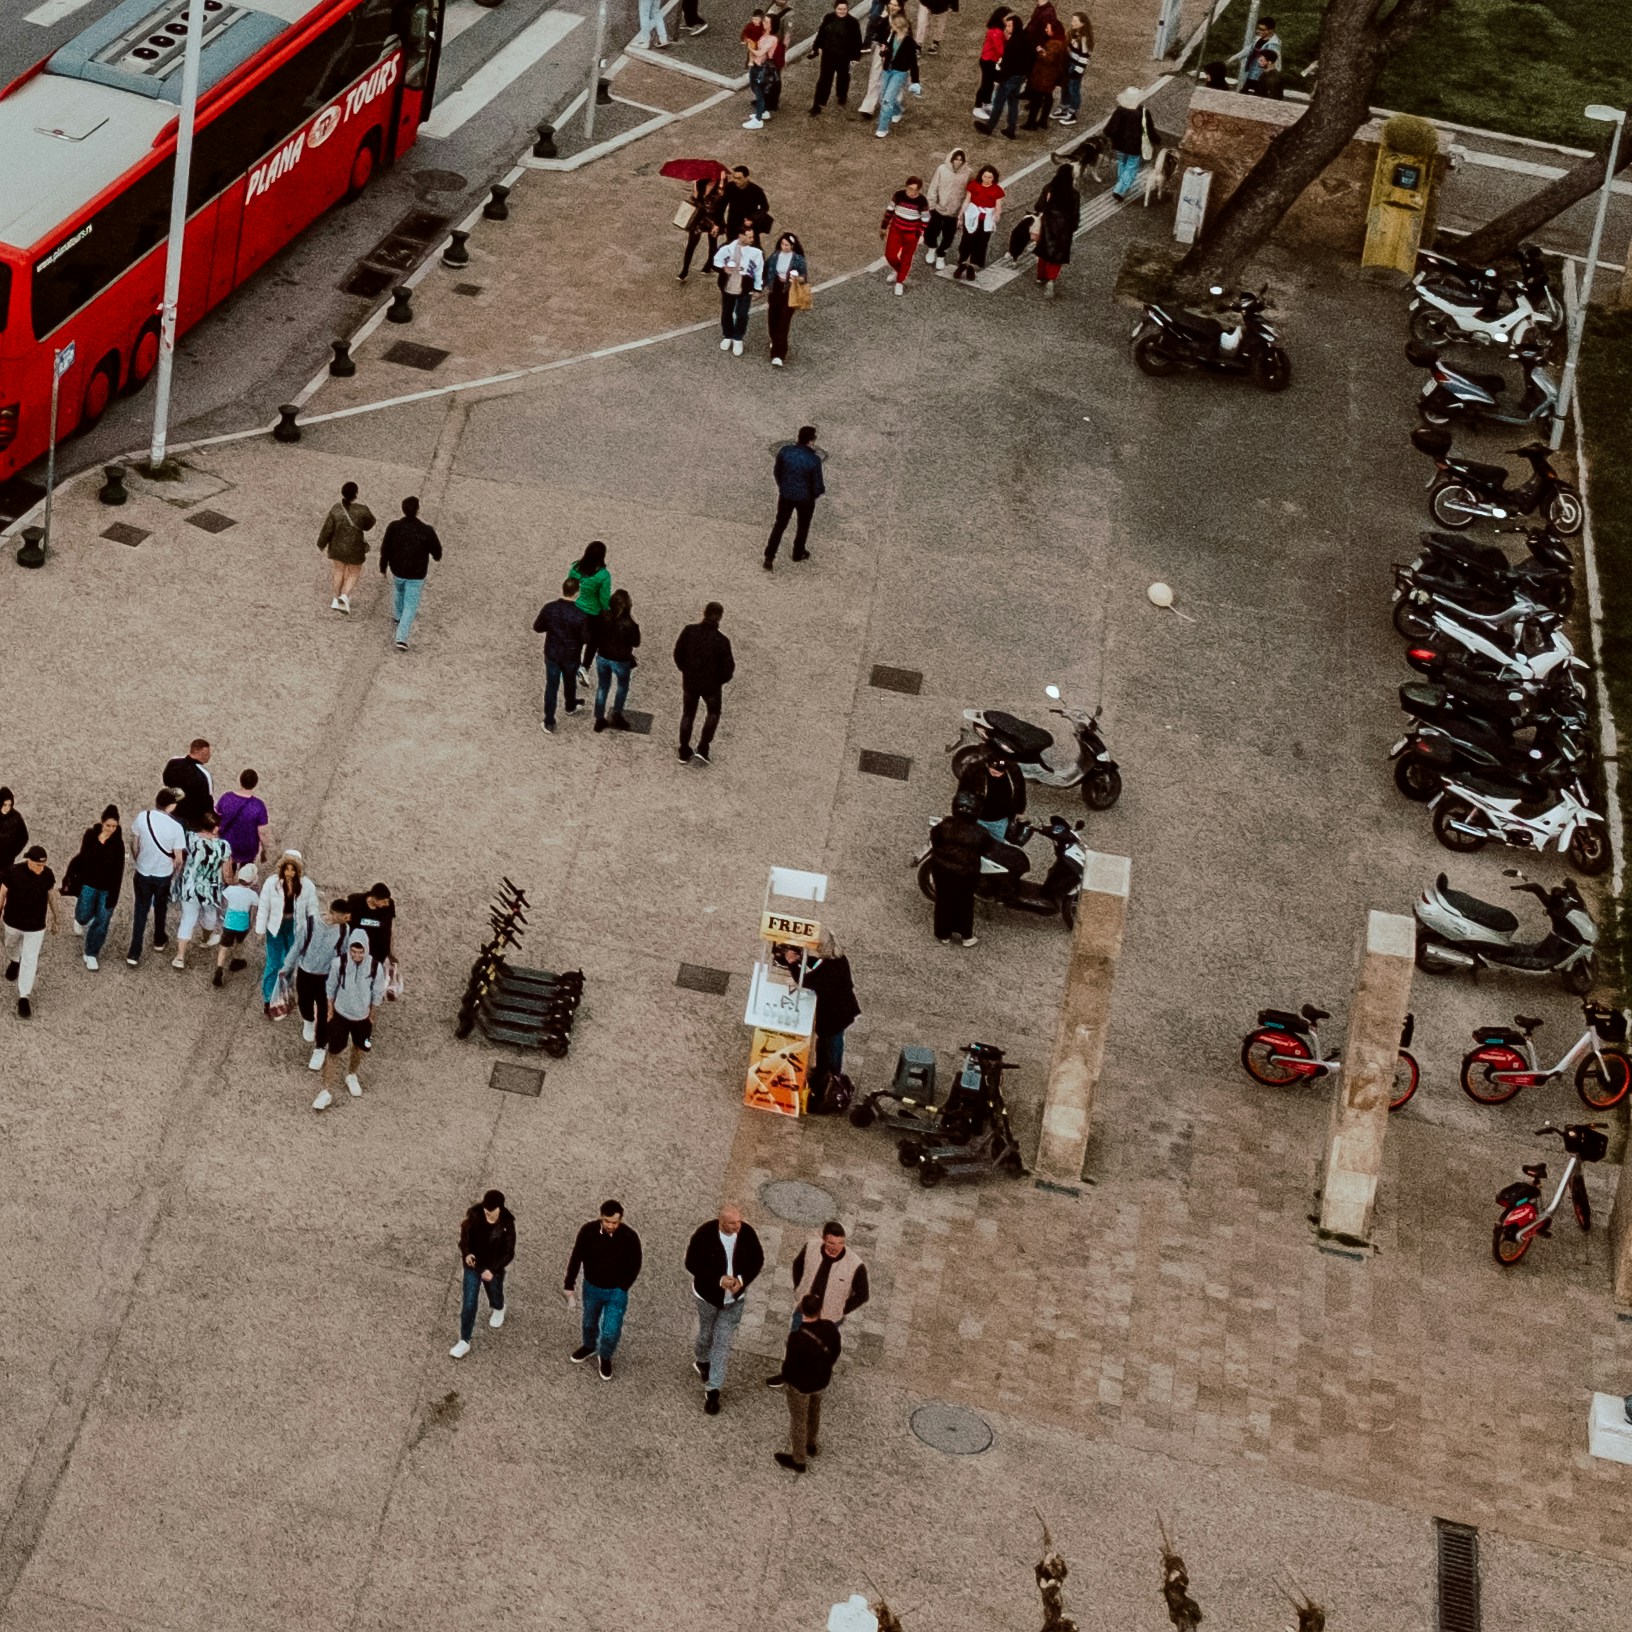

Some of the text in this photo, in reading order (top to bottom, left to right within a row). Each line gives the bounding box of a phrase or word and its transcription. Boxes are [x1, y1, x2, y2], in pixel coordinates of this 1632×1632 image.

[245, 131, 306, 206] PLANA
[343, 52, 401, 125] TOURS
[767, 916, 816, 937] FREE
